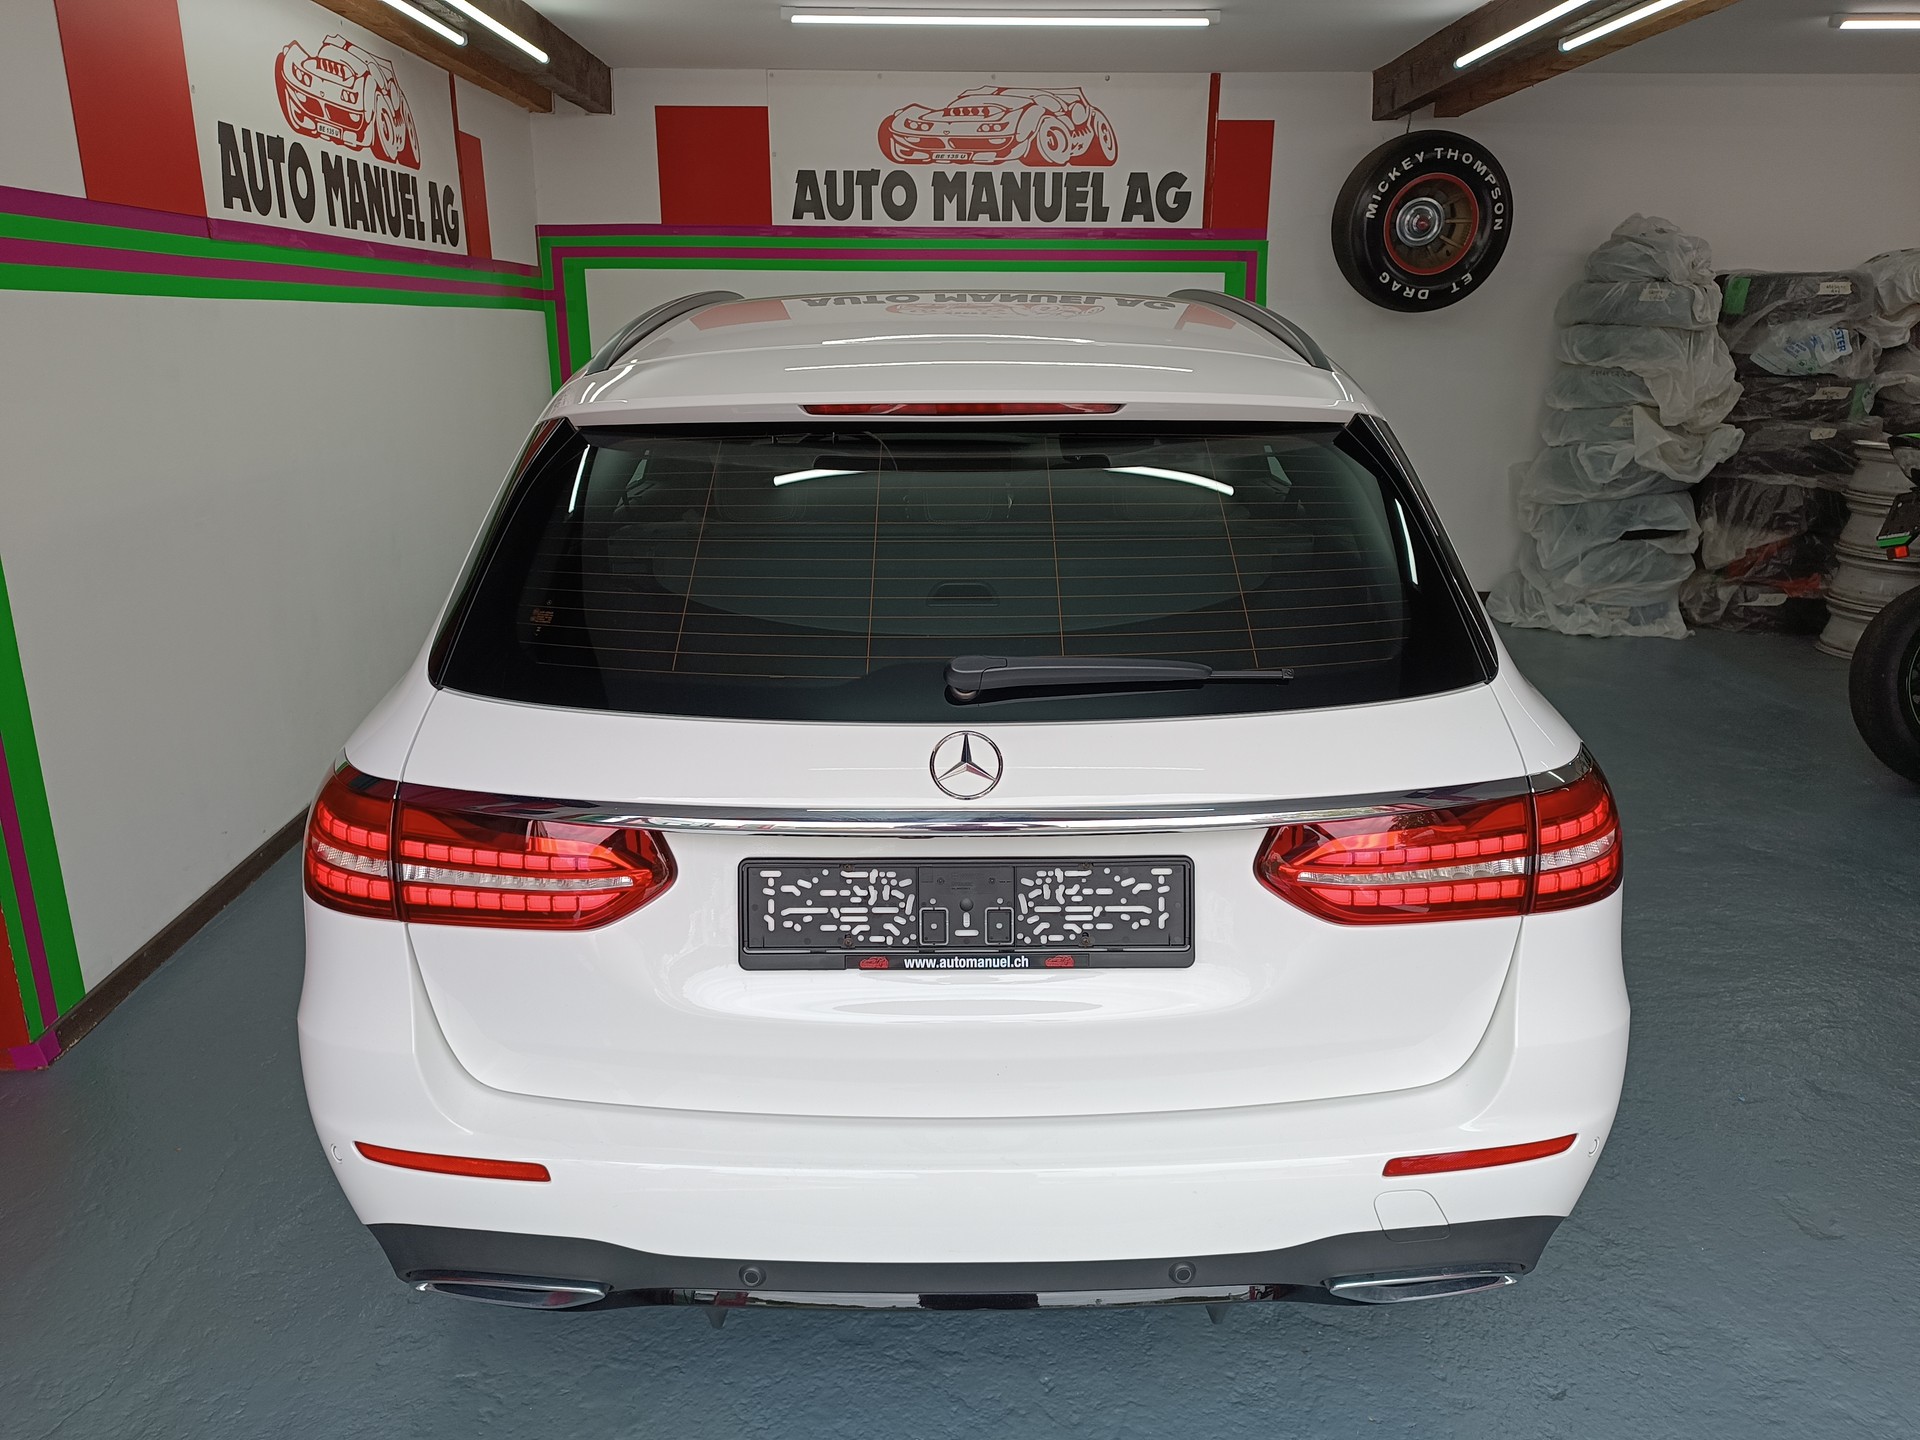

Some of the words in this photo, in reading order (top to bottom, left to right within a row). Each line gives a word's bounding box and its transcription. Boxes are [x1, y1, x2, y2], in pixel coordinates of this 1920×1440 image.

[217, 120, 316, 224] AUTO
[320, 150, 426, 242] MANUEL
[428, 181, 460, 248] AG
[791, 169, 918, 222] AUTO
[931, 170, 1110, 223] MANUEL
[1121, 171, 1192, 223] AG
[1365, 151, 1425, 219] MICKEY
[1434, 147, 1504, 231] THOMPSON
[1379, 271, 1430, 300] DRAG
[1450, 271, 1473, 294] ET
[903, 955, 1030, 969] www.automanuel.ch
